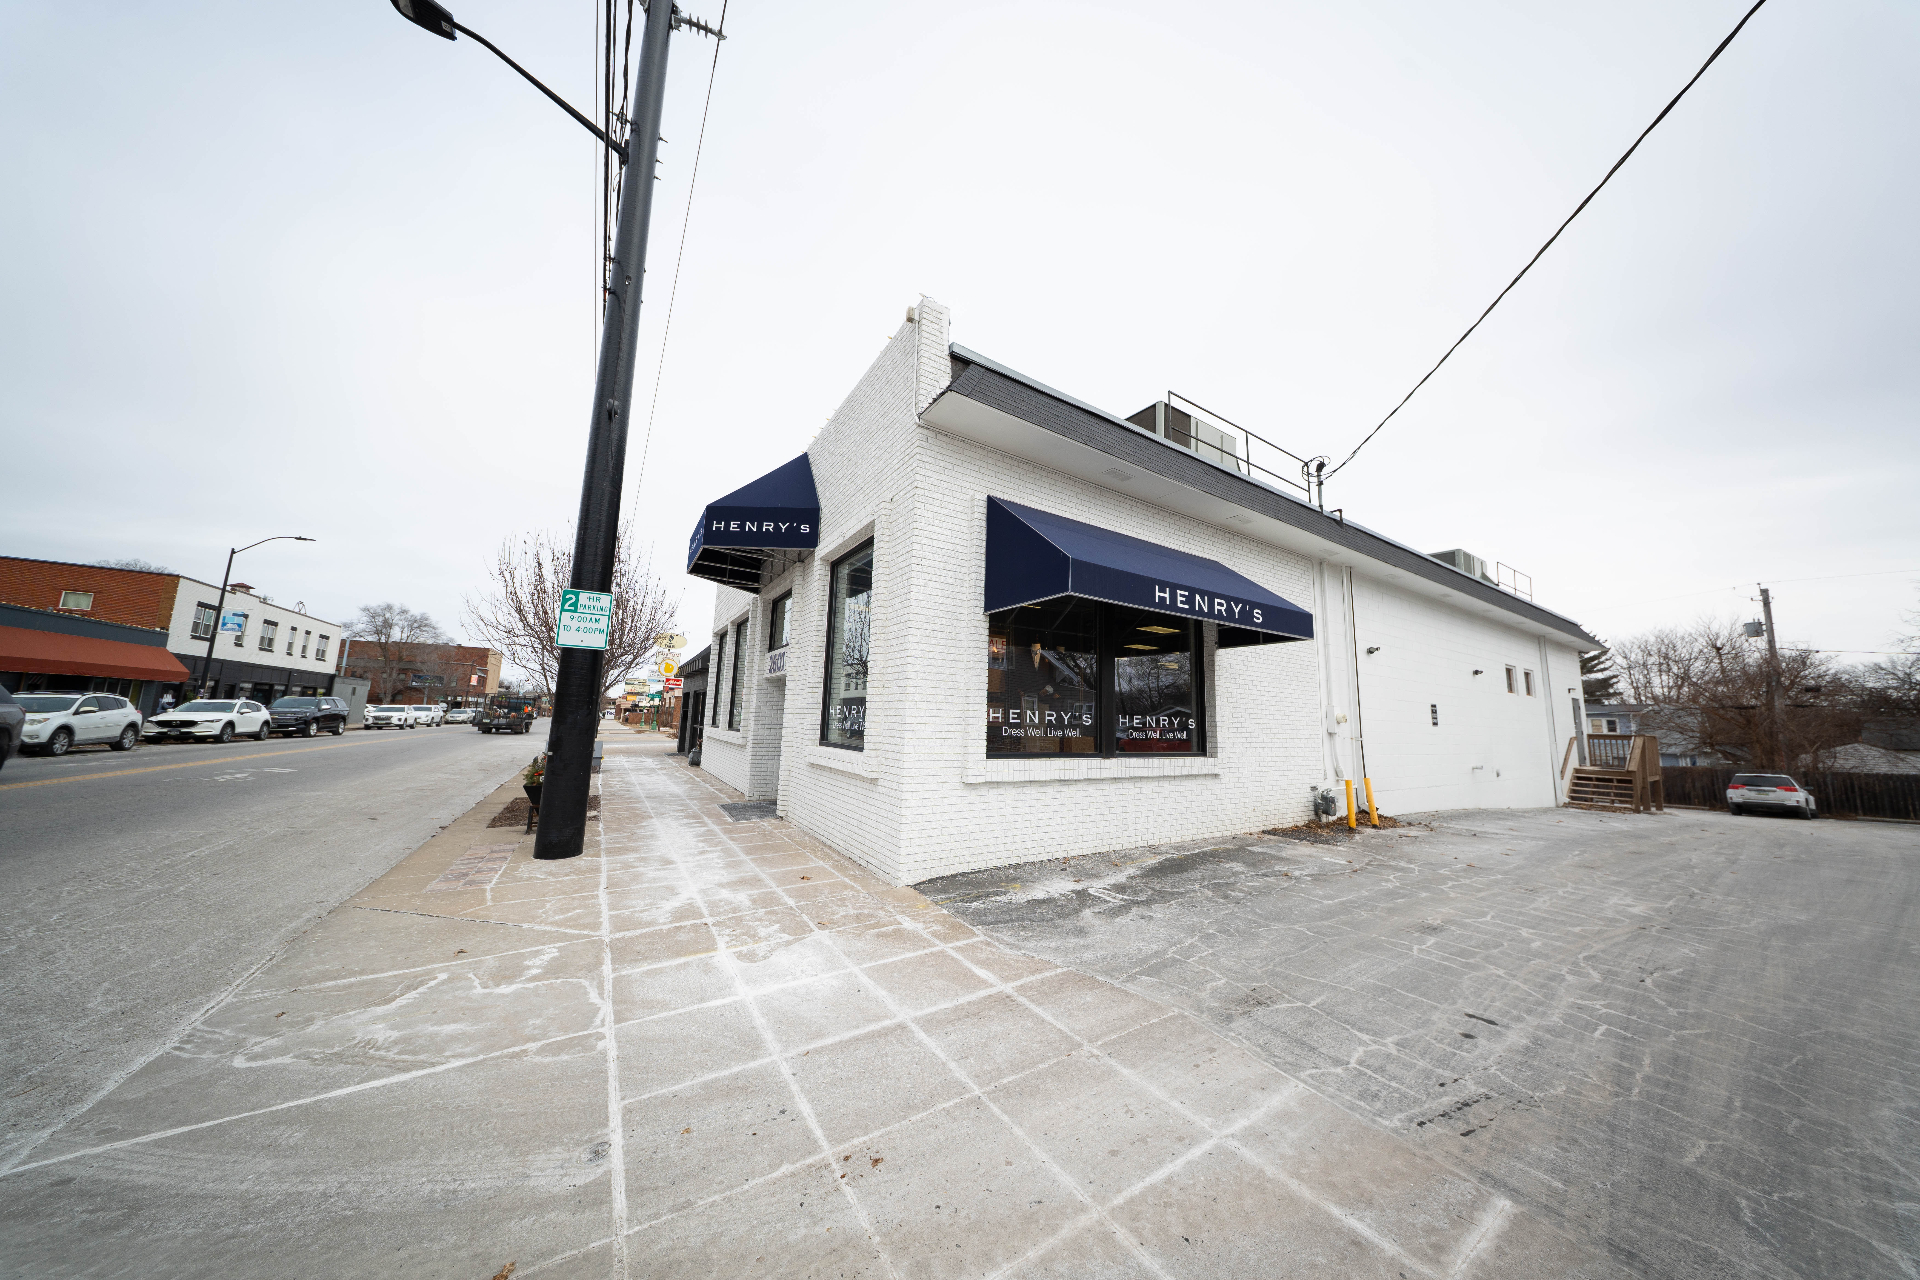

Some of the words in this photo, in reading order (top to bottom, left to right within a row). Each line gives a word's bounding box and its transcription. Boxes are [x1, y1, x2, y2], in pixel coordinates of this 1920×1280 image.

[563, 594, 577, 610] 2
[580, 604, 609, 613] PARKING
[569, 615, 601, 624] 9:00AM
[575, 626, 605, 635] 4:00PM
[1002, 726, 1025, 737] Dress
[1026, 726, 1046, 737] Well.
[1047, 727, 1063, 737] Live
[1064, 728, 1082, 738] Well.
[1128, 729, 1146, 739] Dress
[1162, 730, 1174, 739] Live
